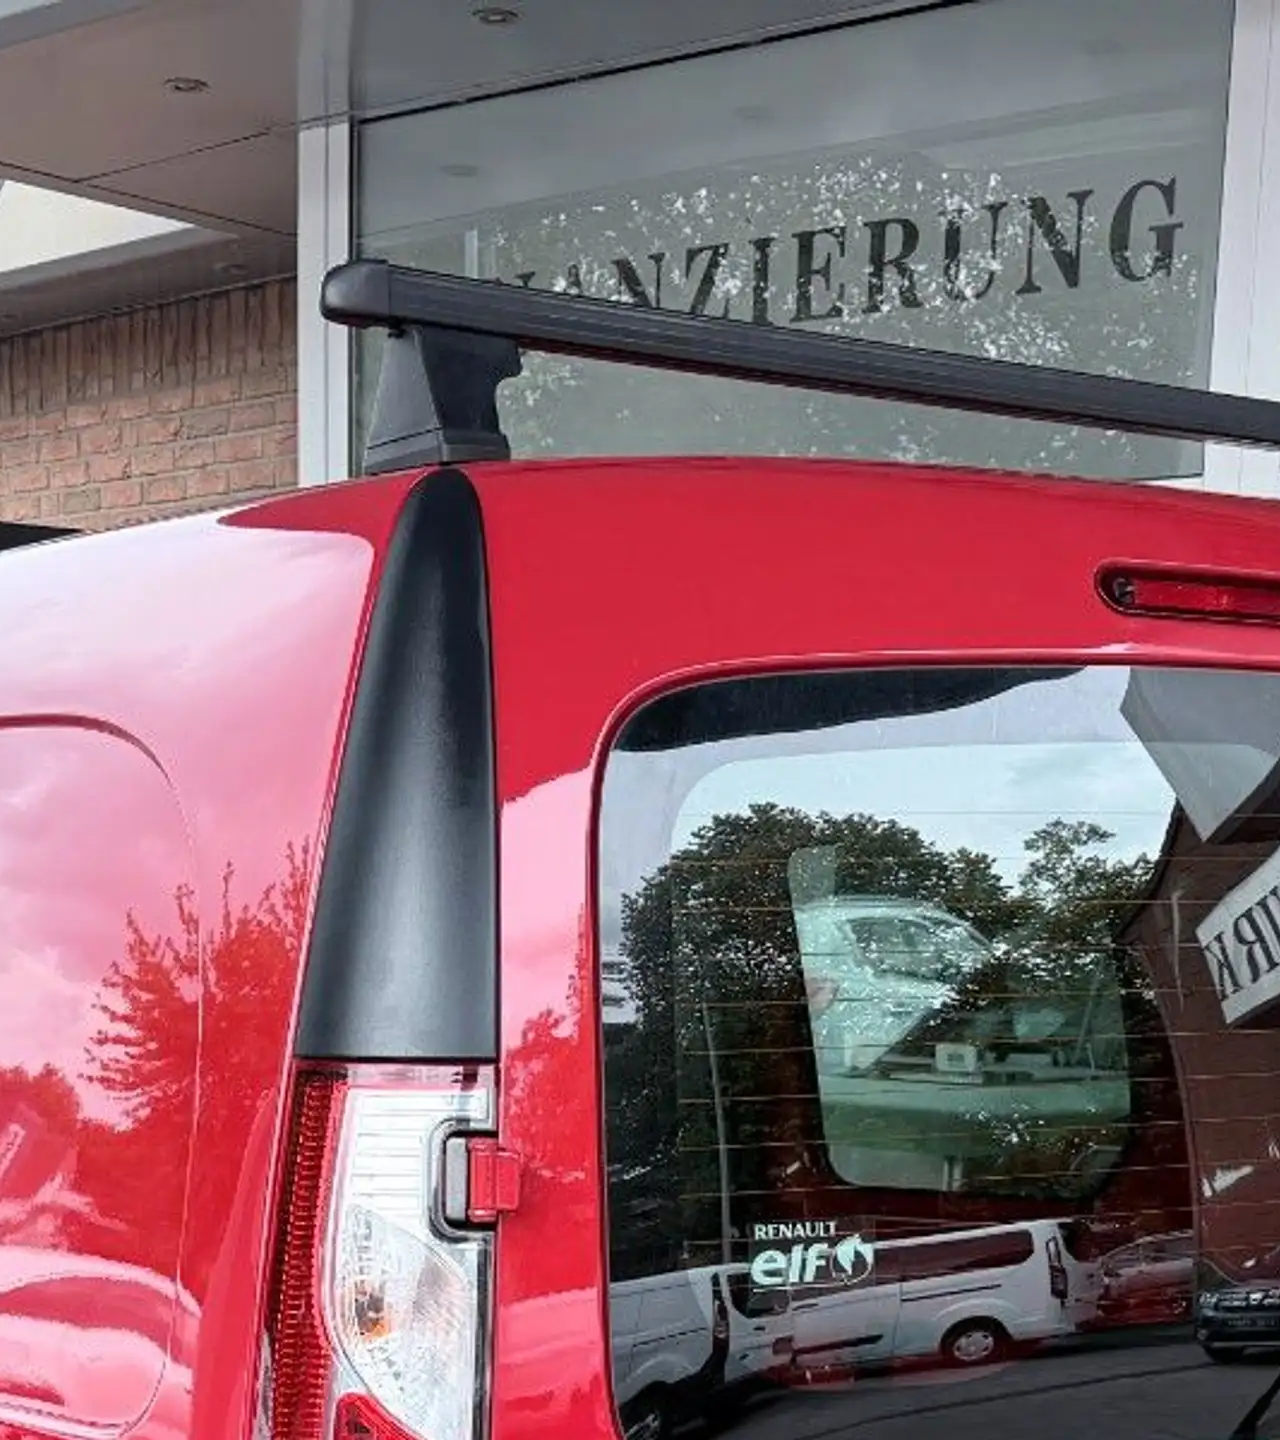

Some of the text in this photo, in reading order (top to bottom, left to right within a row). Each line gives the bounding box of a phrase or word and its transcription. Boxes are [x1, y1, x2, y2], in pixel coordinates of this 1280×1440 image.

[494, 177, 1184, 325] NZIERUNG
[754, 1221, 837, 1241] RENAULT
[750, 1243, 829, 1286] elf
